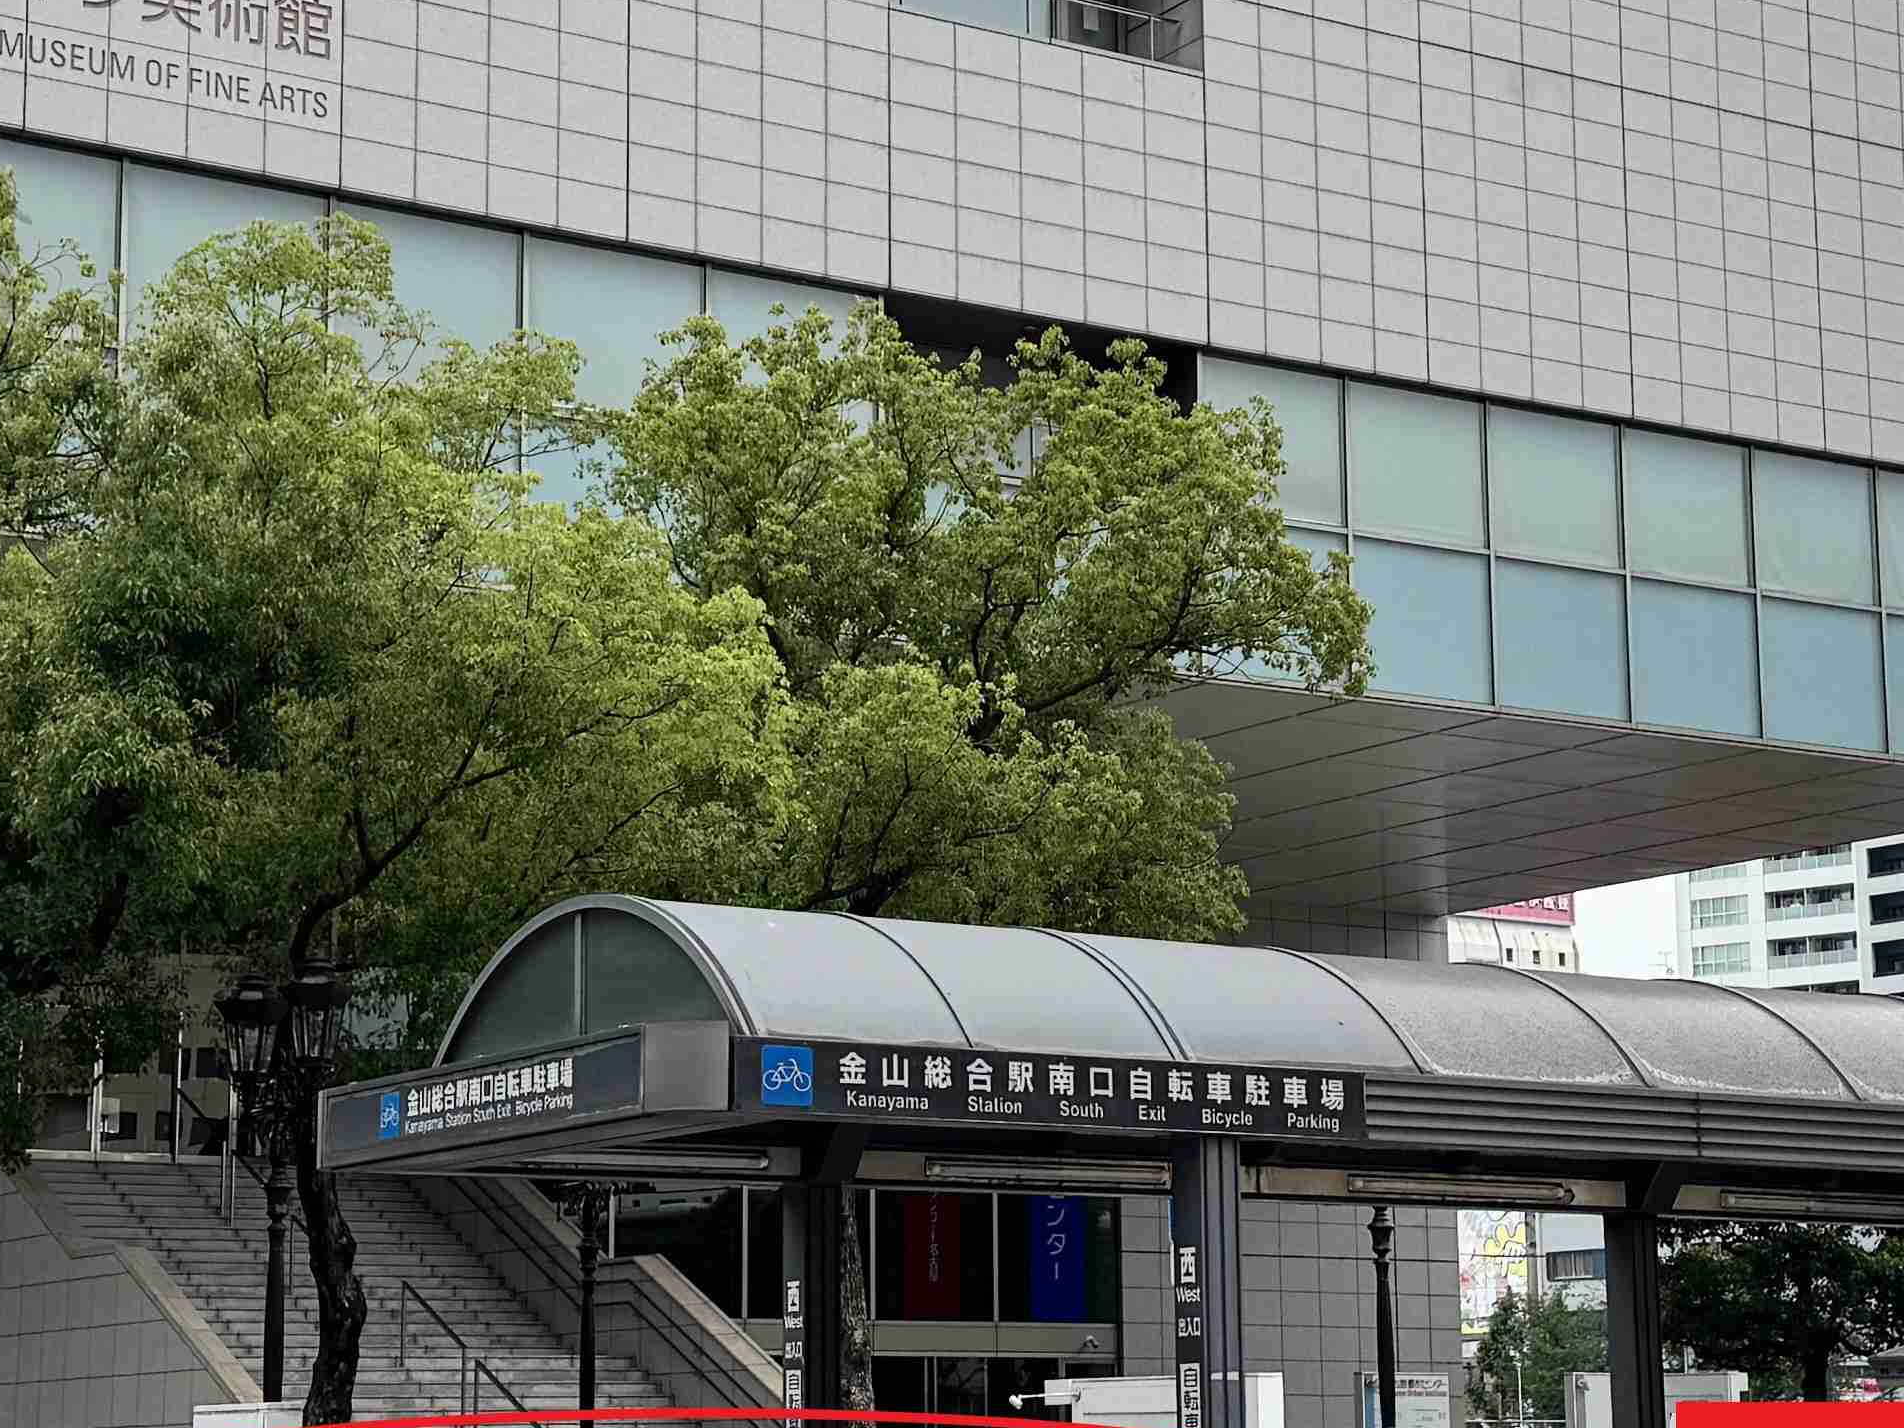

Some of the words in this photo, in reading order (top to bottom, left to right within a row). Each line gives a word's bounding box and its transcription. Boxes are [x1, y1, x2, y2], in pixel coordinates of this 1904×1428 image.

[144, 59, 181, 90] OF
[187, 66, 250, 104] FINE
[260, 81, 329, 119] ARTS
[406, 1058, 574, 1117] 金山総合駅南口自転車駐車場
[838, 1051, 1345, 1112] 金山総合駅南口自転車駐車場
[405, 1116, 444, 1135] Kanayama
[446, 1112, 472, 1128] Station
[473, 1106, 496, 1123] South
[497, 1103, 512, 1118] Exit
[515, 1098, 544, 1118] Bicycle
[544, 1092, 574, 1111] Parking
[846, 1089, 929, 1112] Kanayama
[967, 1093, 1022, 1115] Station
[1059, 1100, 1104, 1120] South
[1138, 1104, 1167, 1123] Exit
[1201, 1108, 1253, 1128] Bicycle
[1287, 1113, 1340, 1134] Parking
[1179, 1246, 1196, 1284] 西
[1176, 1288, 1201, 1304] West
[784, 1315, 804, 1329] West
